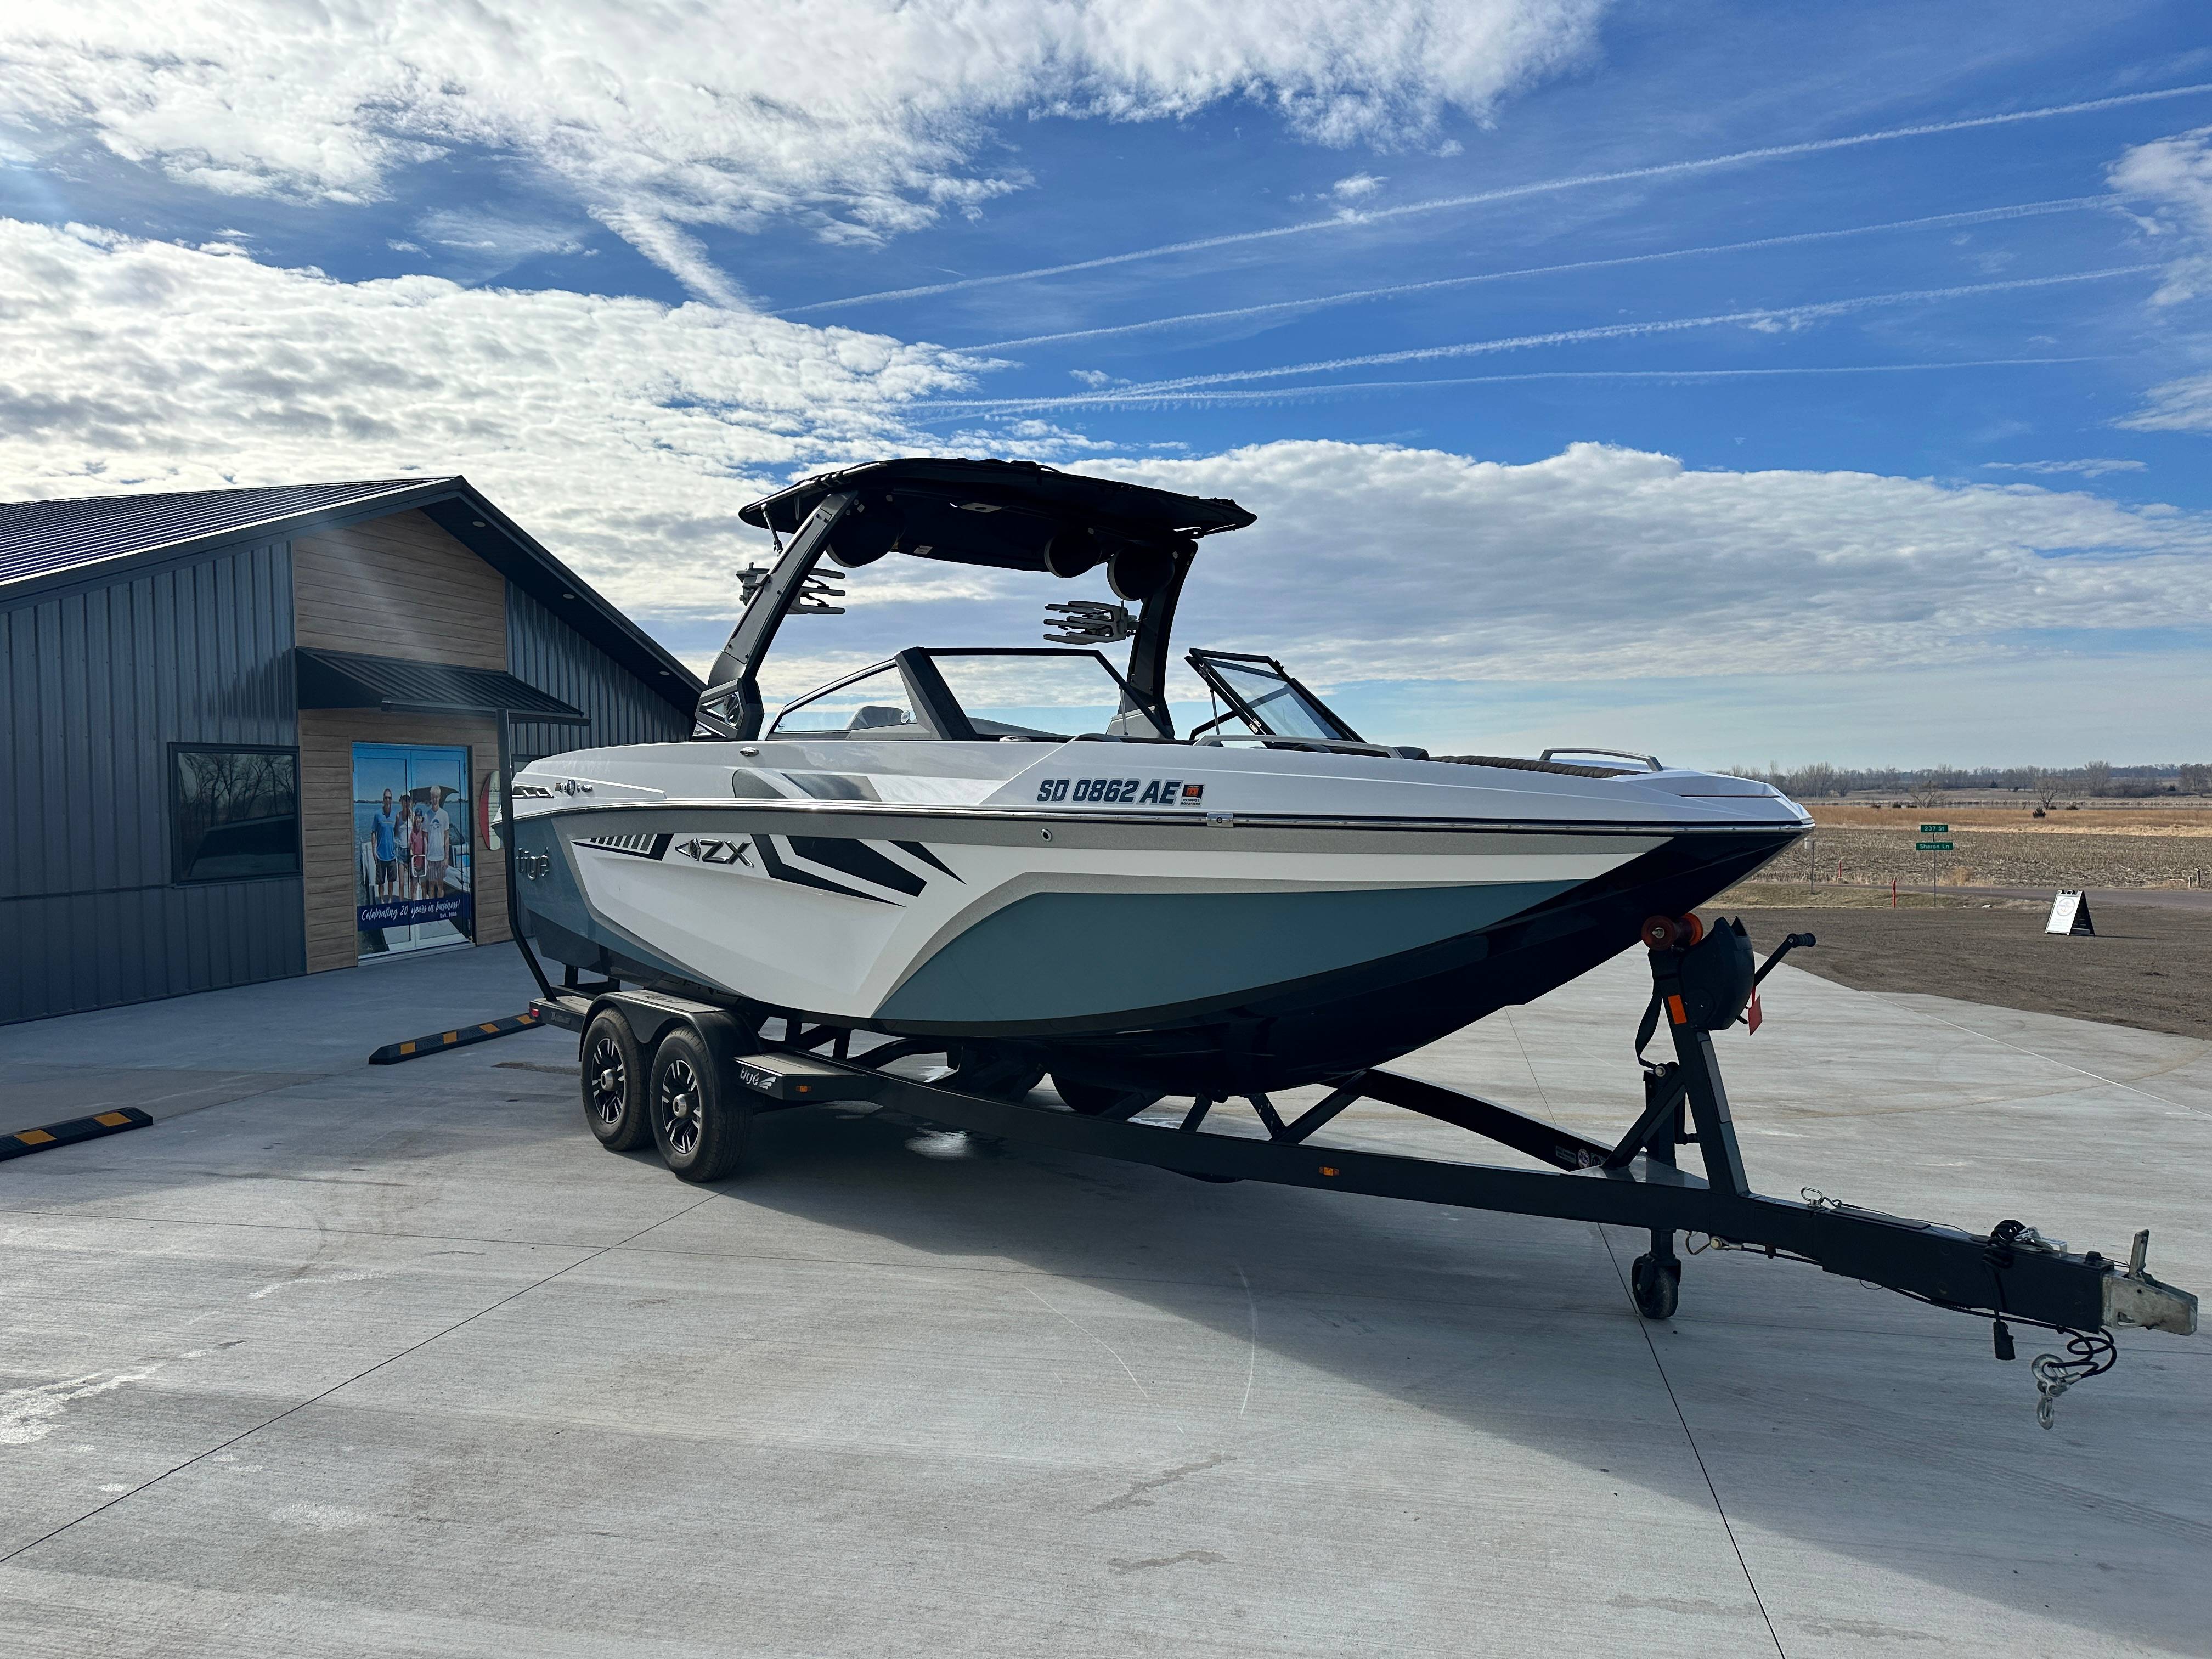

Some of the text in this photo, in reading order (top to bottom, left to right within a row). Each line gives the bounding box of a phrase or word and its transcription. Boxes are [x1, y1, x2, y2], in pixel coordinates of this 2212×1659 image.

[1037, 780, 1183, 804] SD 0862 AE
[699, 838, 755, 868] ZX
[362, 898, 461, 921] Celebrating 20 years in business!
[740, 1067, 760, 1086] tigé
